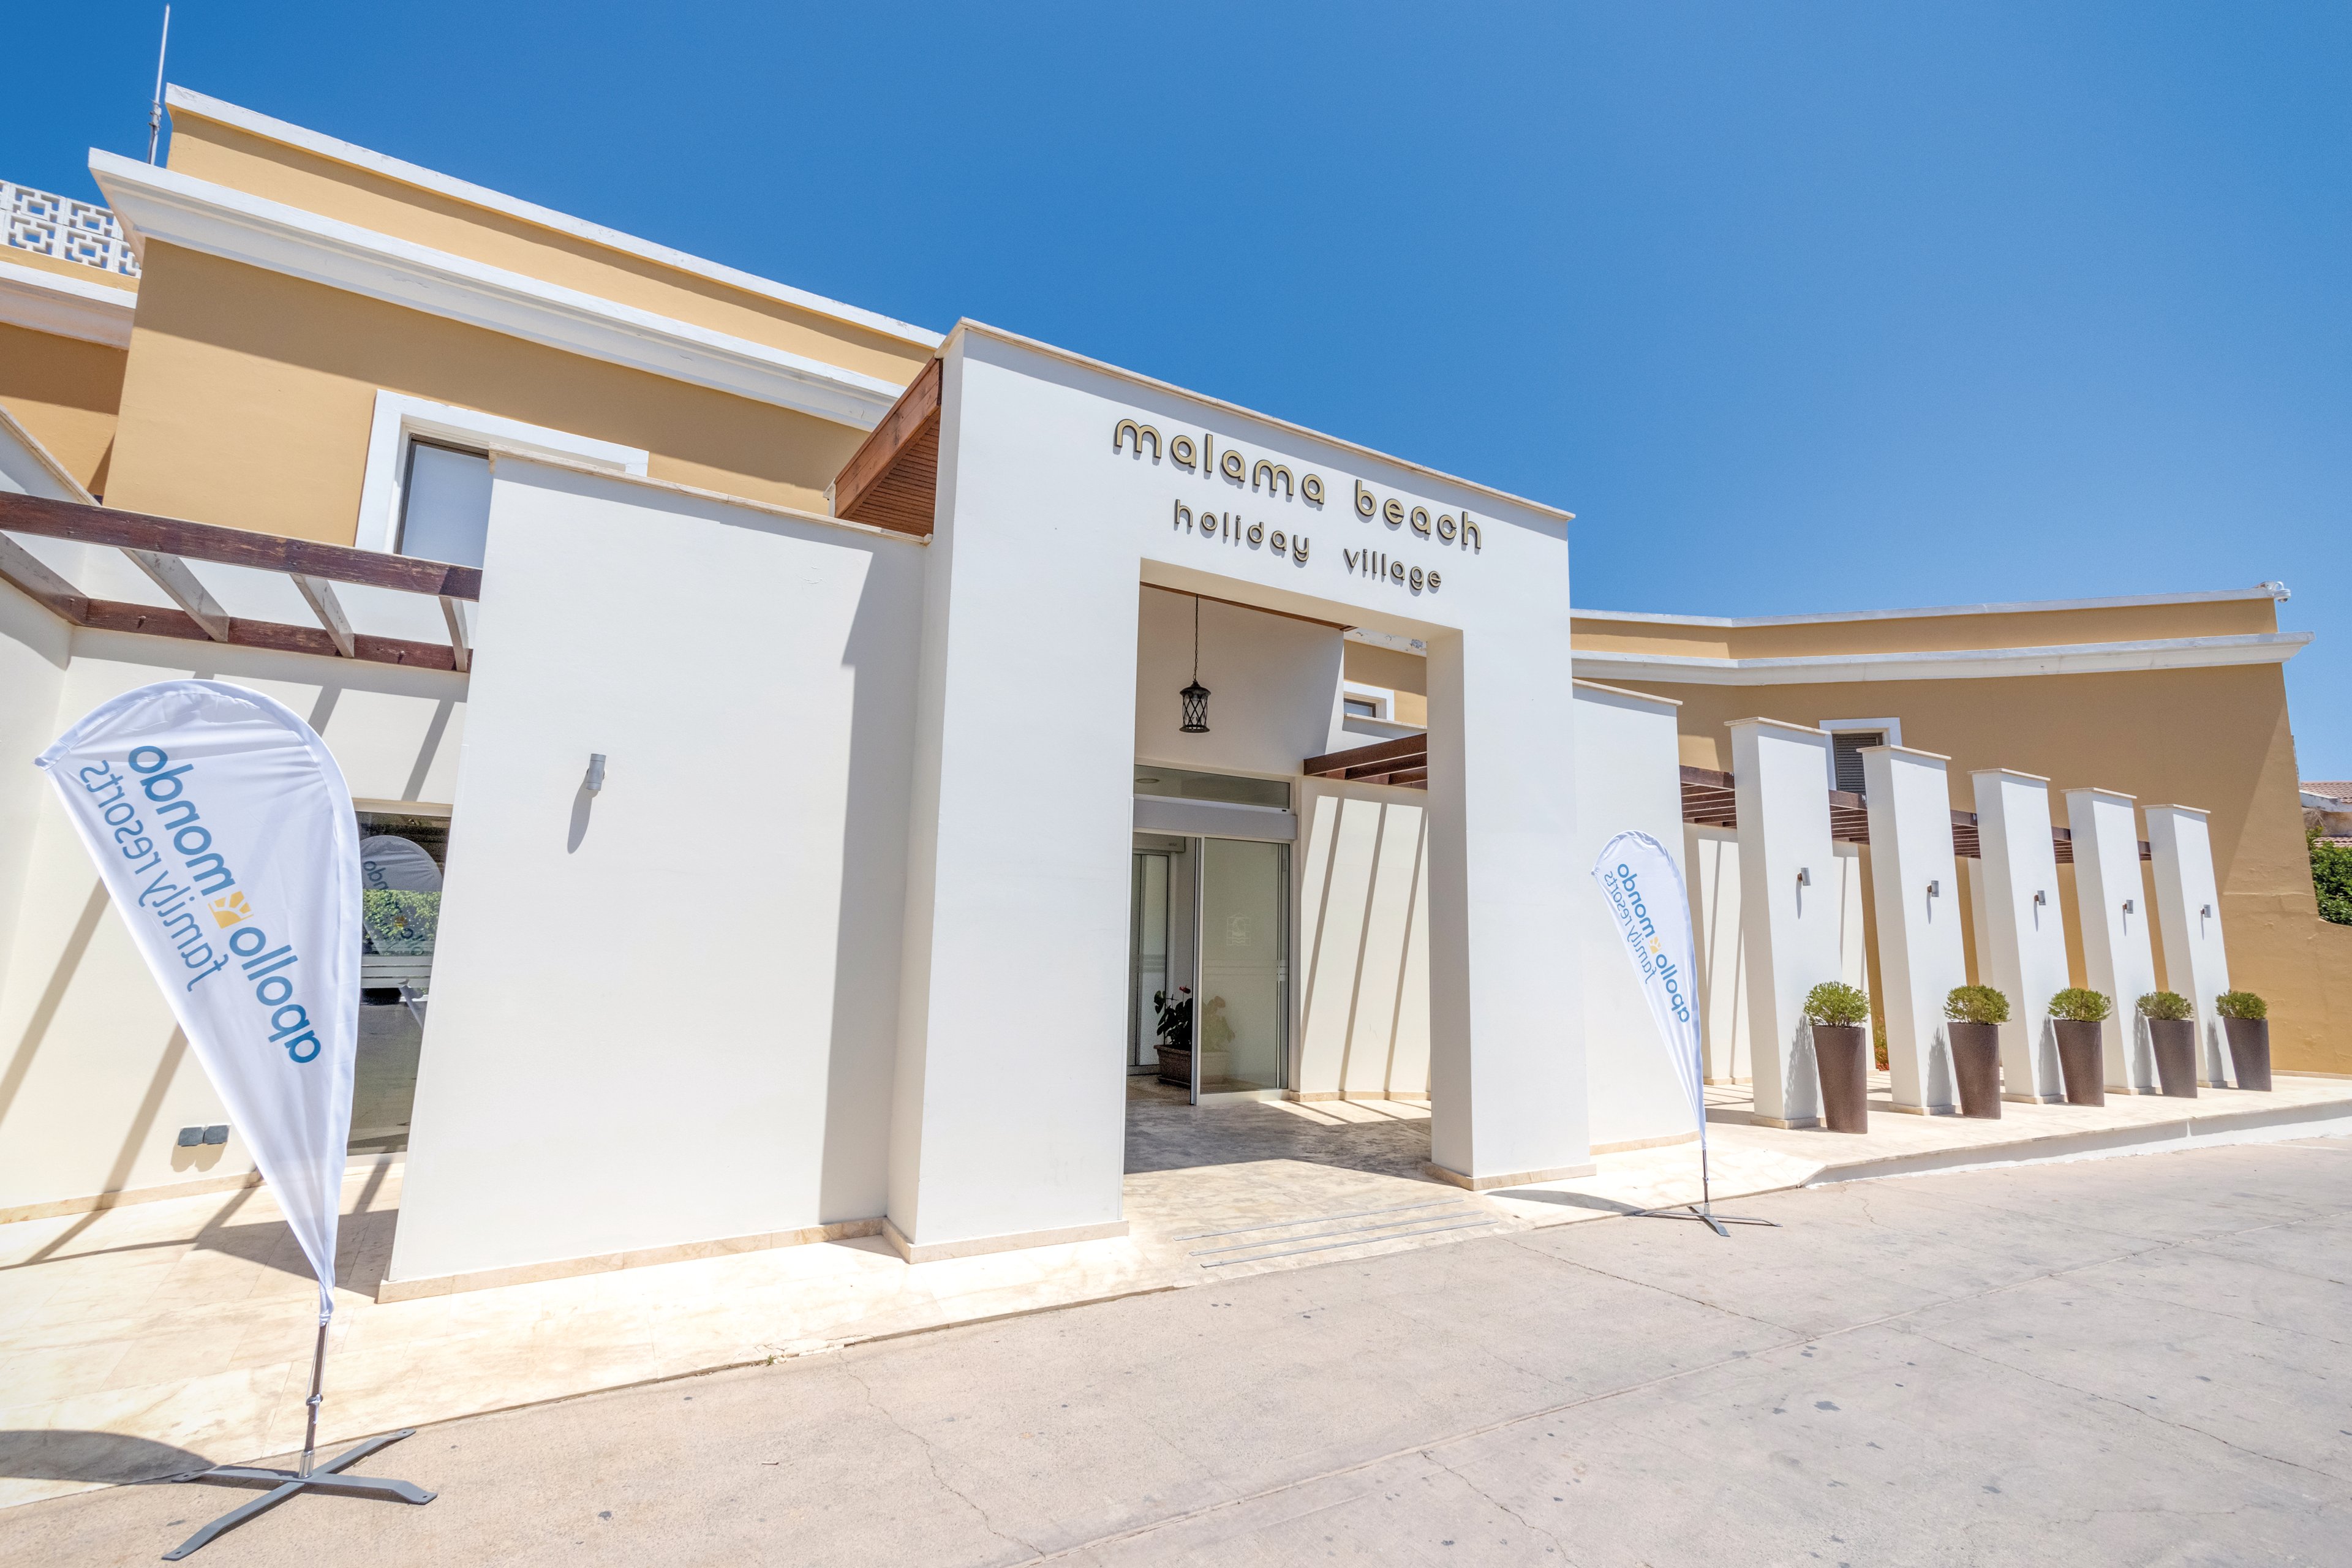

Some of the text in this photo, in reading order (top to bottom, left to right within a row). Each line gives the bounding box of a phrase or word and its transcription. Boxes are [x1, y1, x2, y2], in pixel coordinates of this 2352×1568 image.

[1115, 419, 1482, 549] malama beach
[1174, 499, 1442, 590] holiday village
